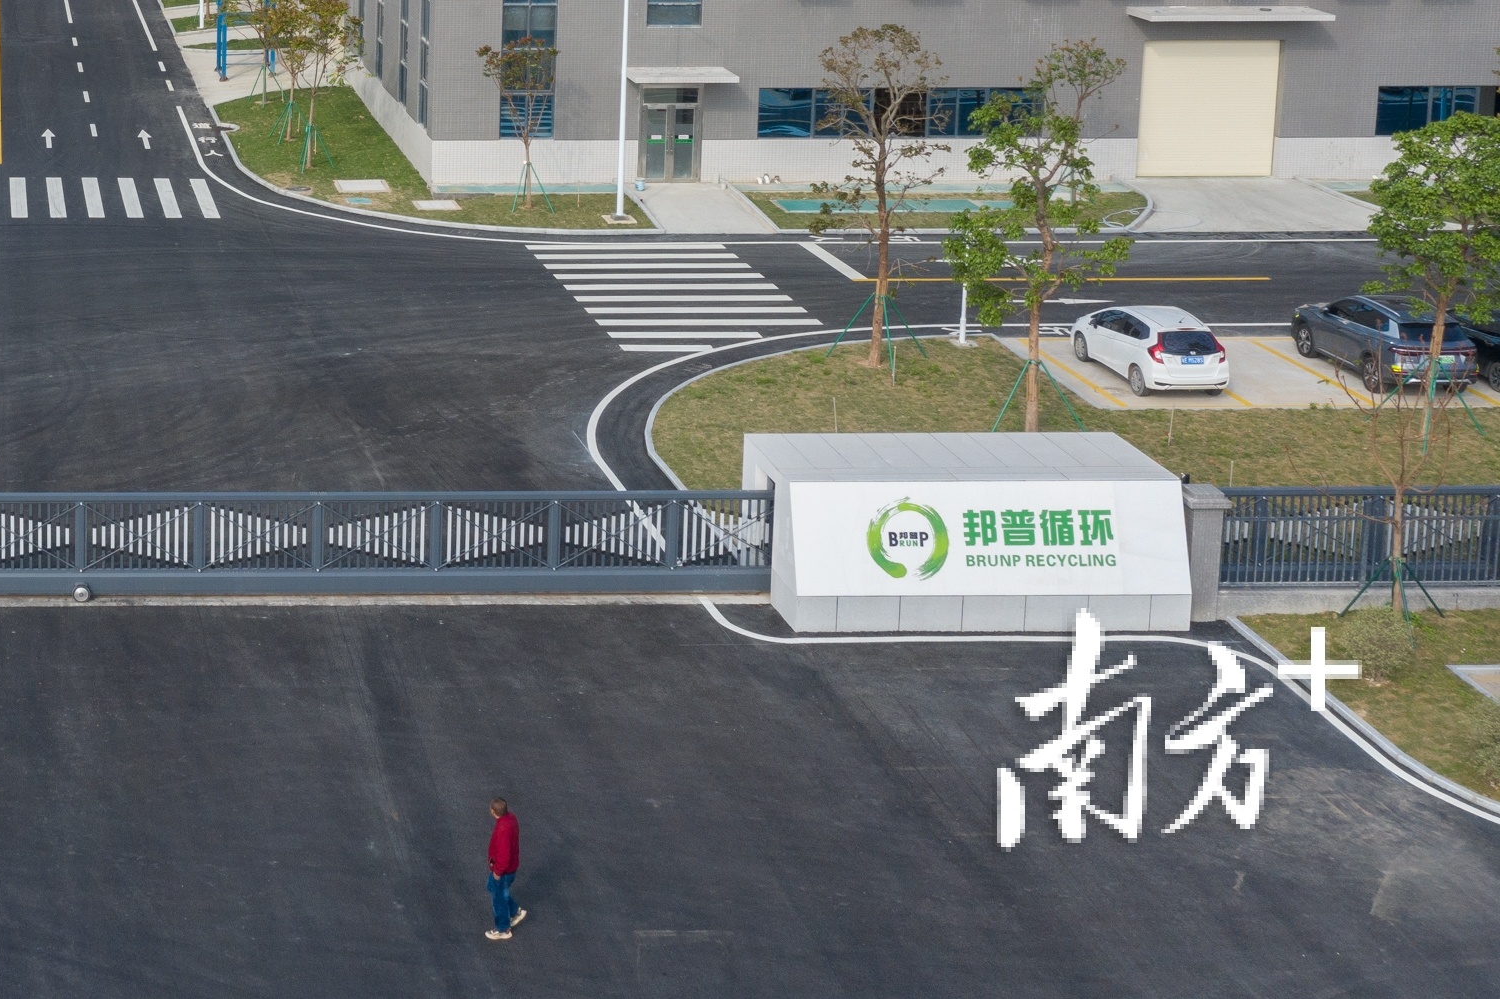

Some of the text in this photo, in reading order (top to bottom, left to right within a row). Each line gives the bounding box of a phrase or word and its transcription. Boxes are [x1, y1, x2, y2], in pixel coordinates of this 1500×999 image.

[963, 509, 1114, 547] 邦普循环
[966, 554, 1117, 567] BRUNP RECYCLING
